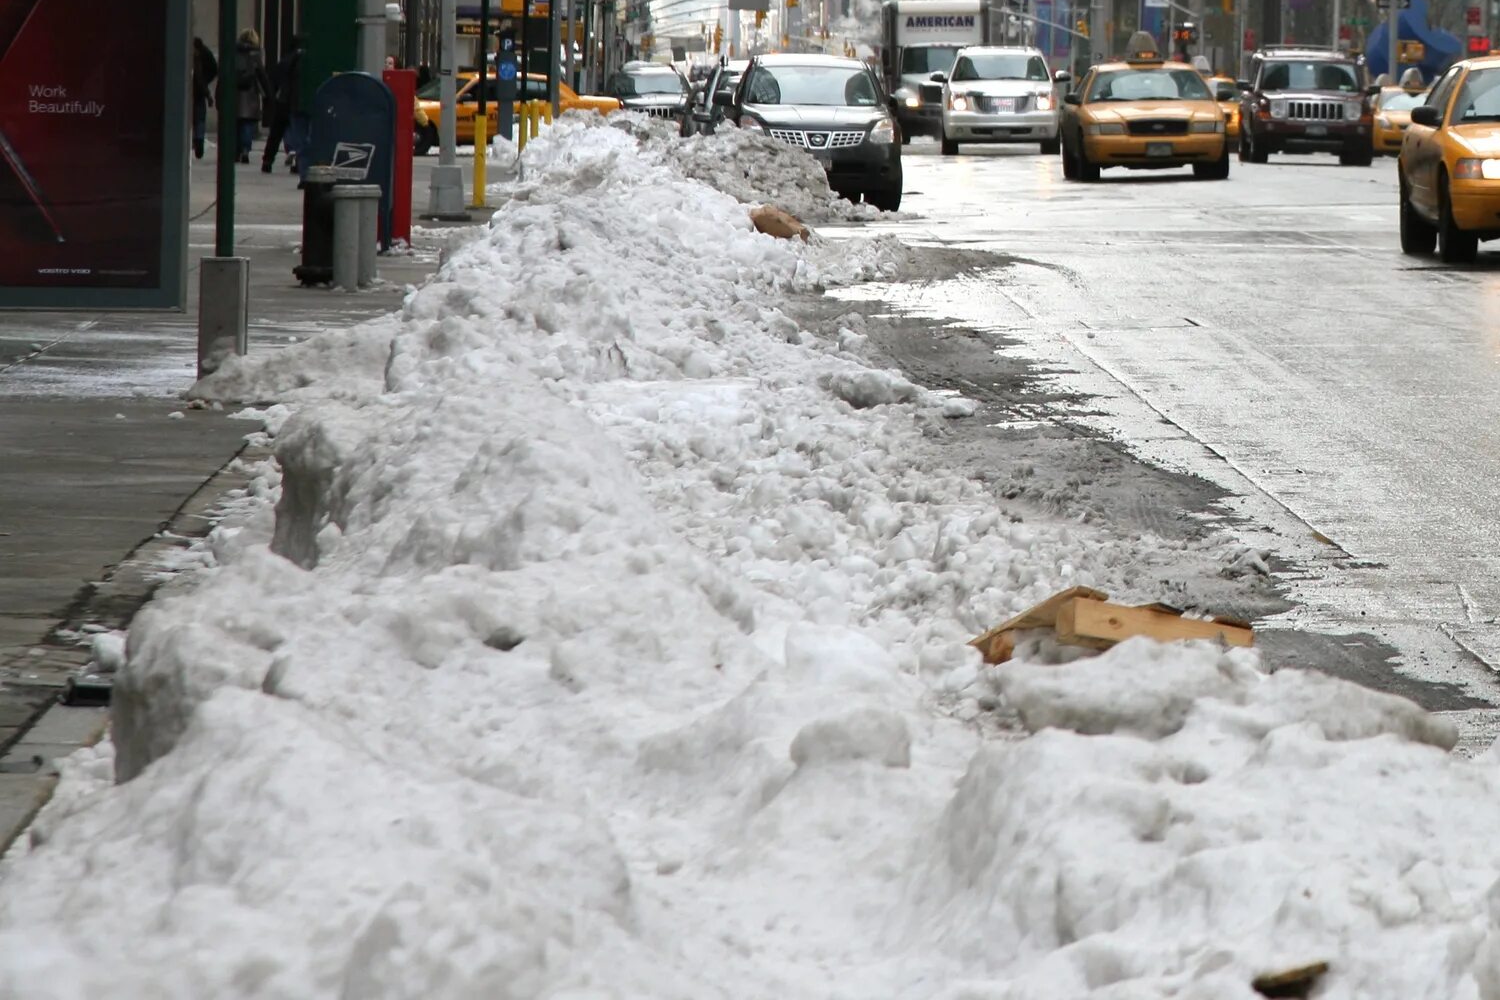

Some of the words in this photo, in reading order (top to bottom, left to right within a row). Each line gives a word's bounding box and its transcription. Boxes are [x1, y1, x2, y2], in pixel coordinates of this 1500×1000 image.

[905, 15, 975, 28] AMERICAN
[28, 84, 67, 98] Work
[28, 100, 105, 117] Beautifully
